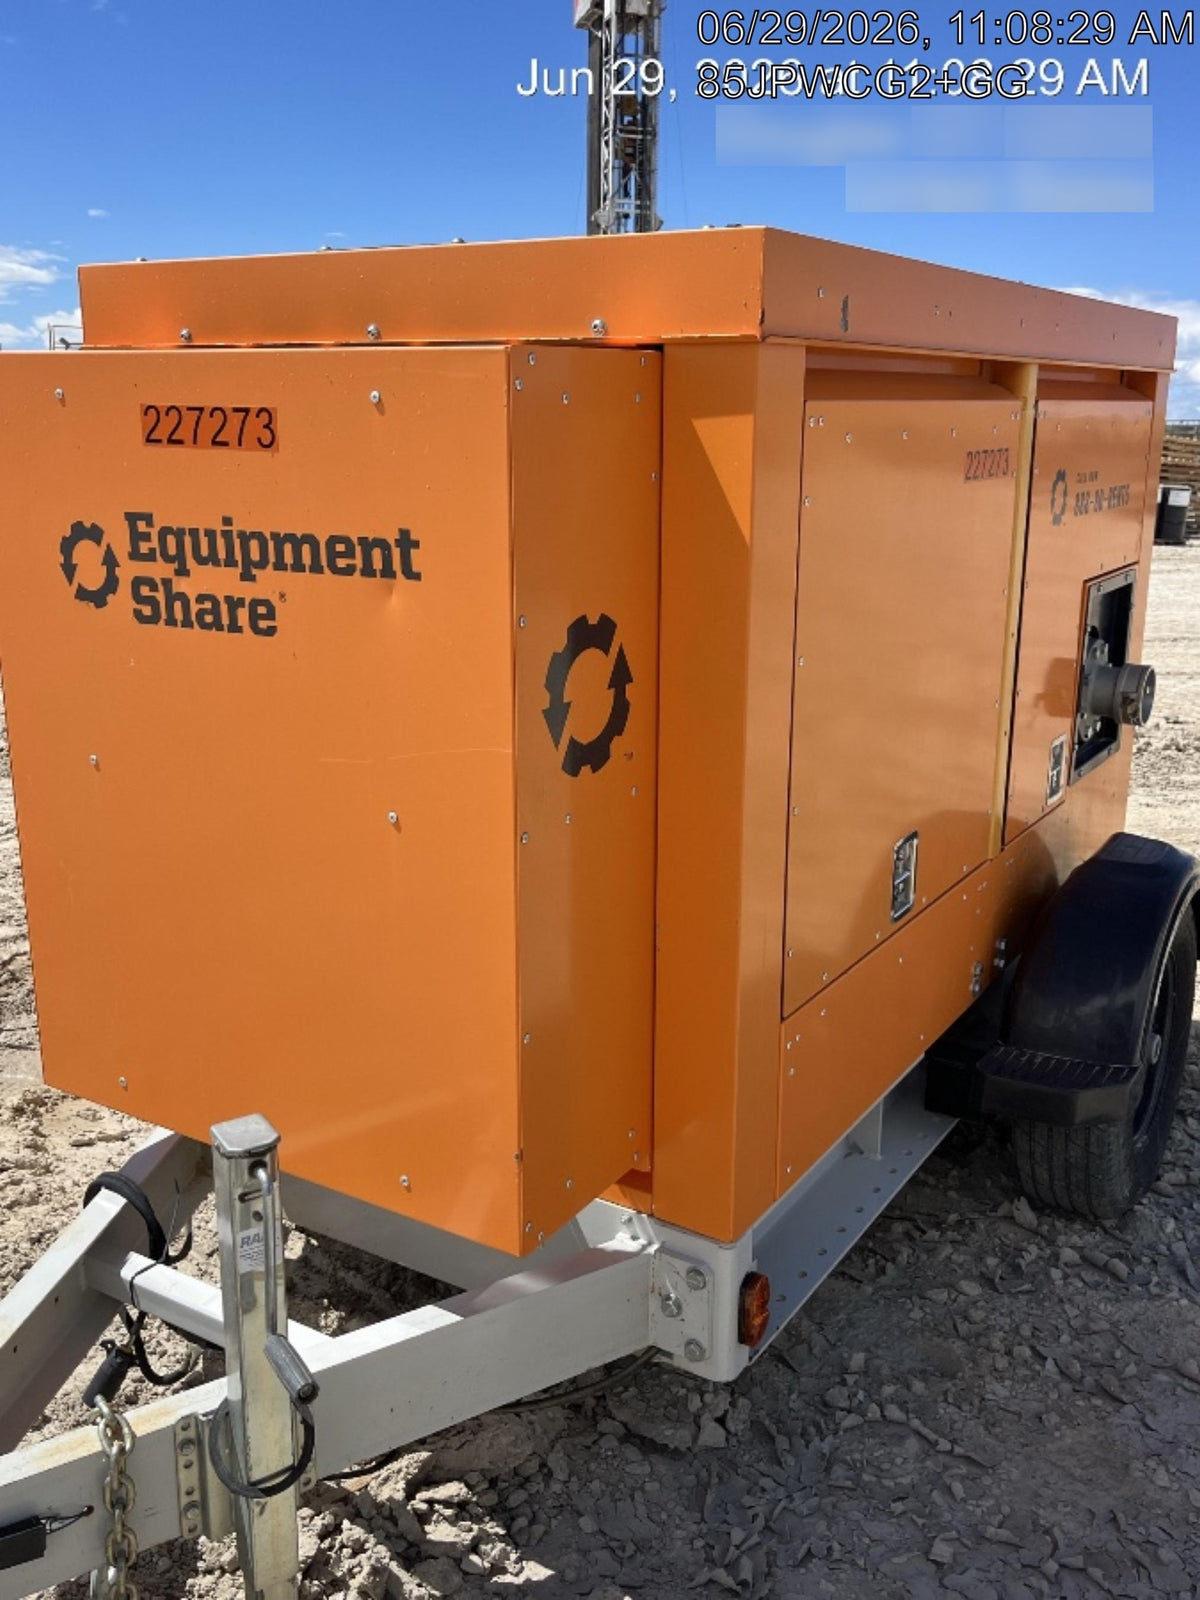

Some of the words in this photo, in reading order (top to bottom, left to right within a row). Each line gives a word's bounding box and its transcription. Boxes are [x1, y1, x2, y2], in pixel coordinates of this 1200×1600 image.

[143, 405, 276, 449] 227273
[964, 447, 1009, 481] 227273
[124, 512, 422, 582] Equipment
[131, 575, 278, 637] Share
